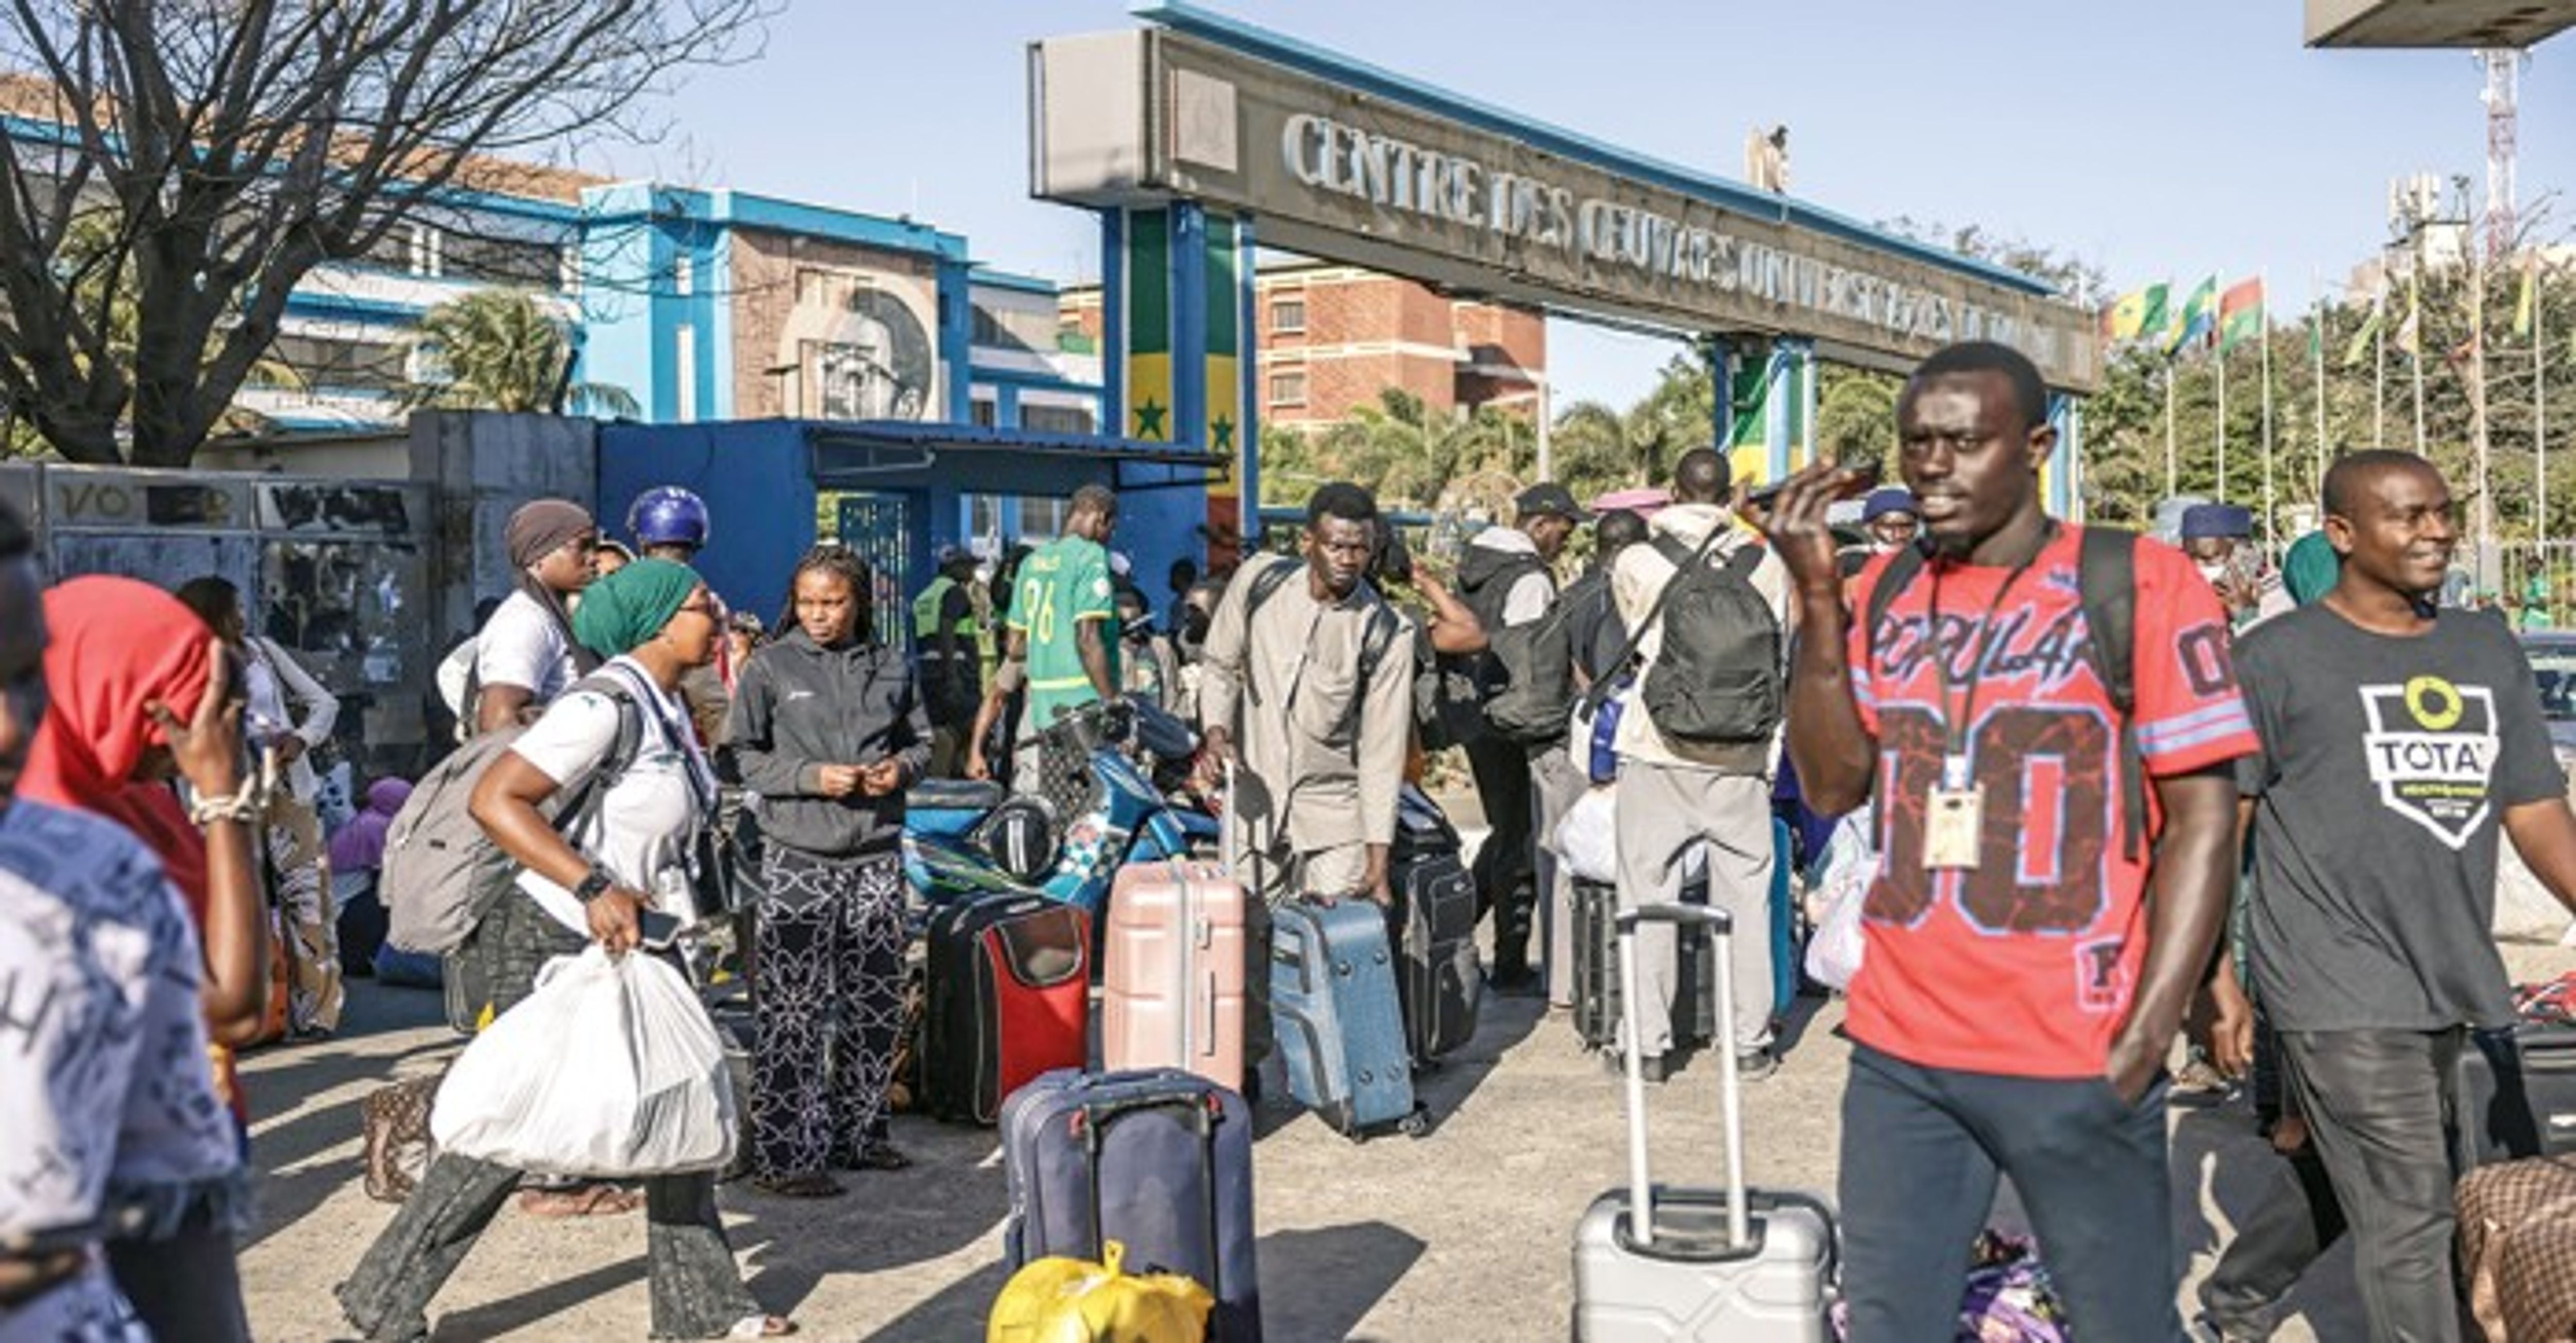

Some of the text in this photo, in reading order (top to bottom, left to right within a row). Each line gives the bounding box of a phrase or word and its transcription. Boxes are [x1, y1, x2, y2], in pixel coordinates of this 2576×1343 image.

[1283, 113, 1484, 226] CENTRE
[1490, 172, 1572, 252] DES
[2374, 742, 2485, 773] TOTA
